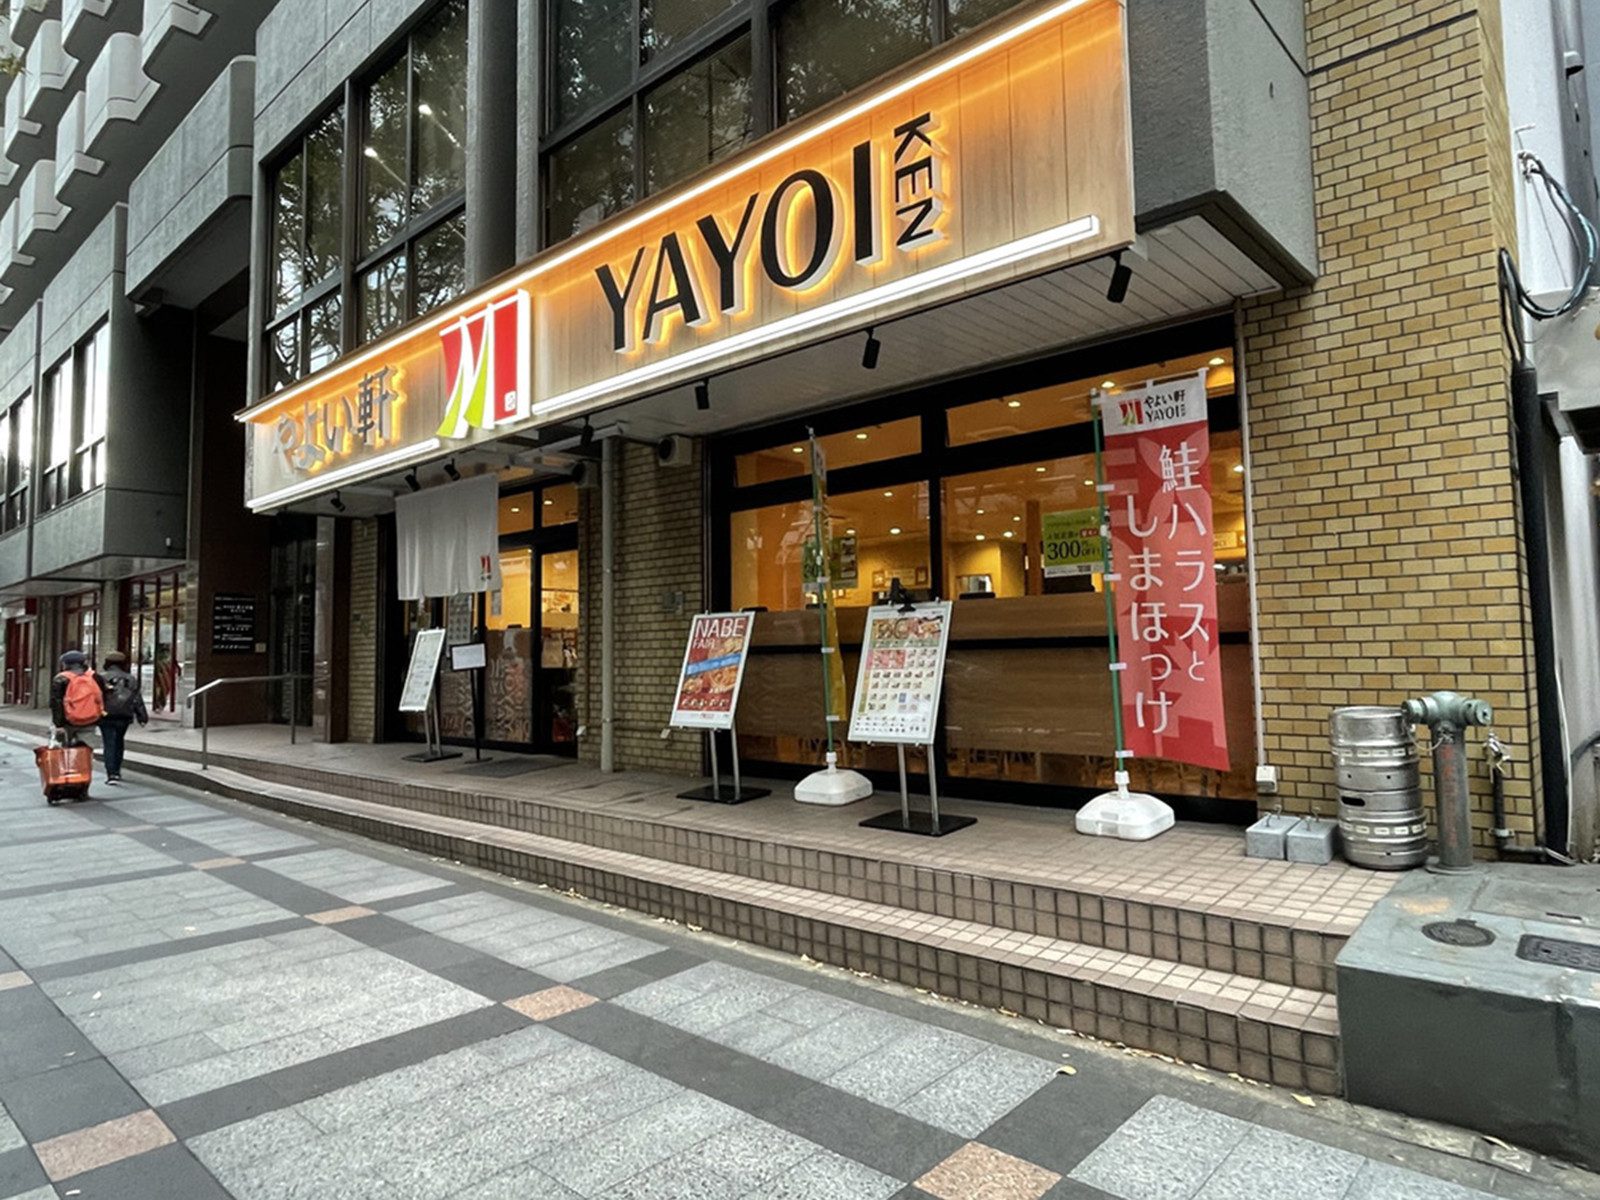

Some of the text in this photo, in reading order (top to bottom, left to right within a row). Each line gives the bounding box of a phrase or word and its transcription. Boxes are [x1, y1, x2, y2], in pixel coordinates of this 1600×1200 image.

[893, 111, 938, 248] KEN
[596, 141, 877, 352] YAYOI
[273, 365, 400, 476] やよい軒
[1144, 389, 1186, 409] やよい軒
[1145, 405, 1180, 423] YAYOI
[1047, 540, 1081, 561] 300
[1158, 441, 1211, 683] 鮭ハラスと
[692, 638, 717, 649] FAIR
[694, 618, 746, 639] NABE
[1126, 494, 1174, 735] しまほっけ
